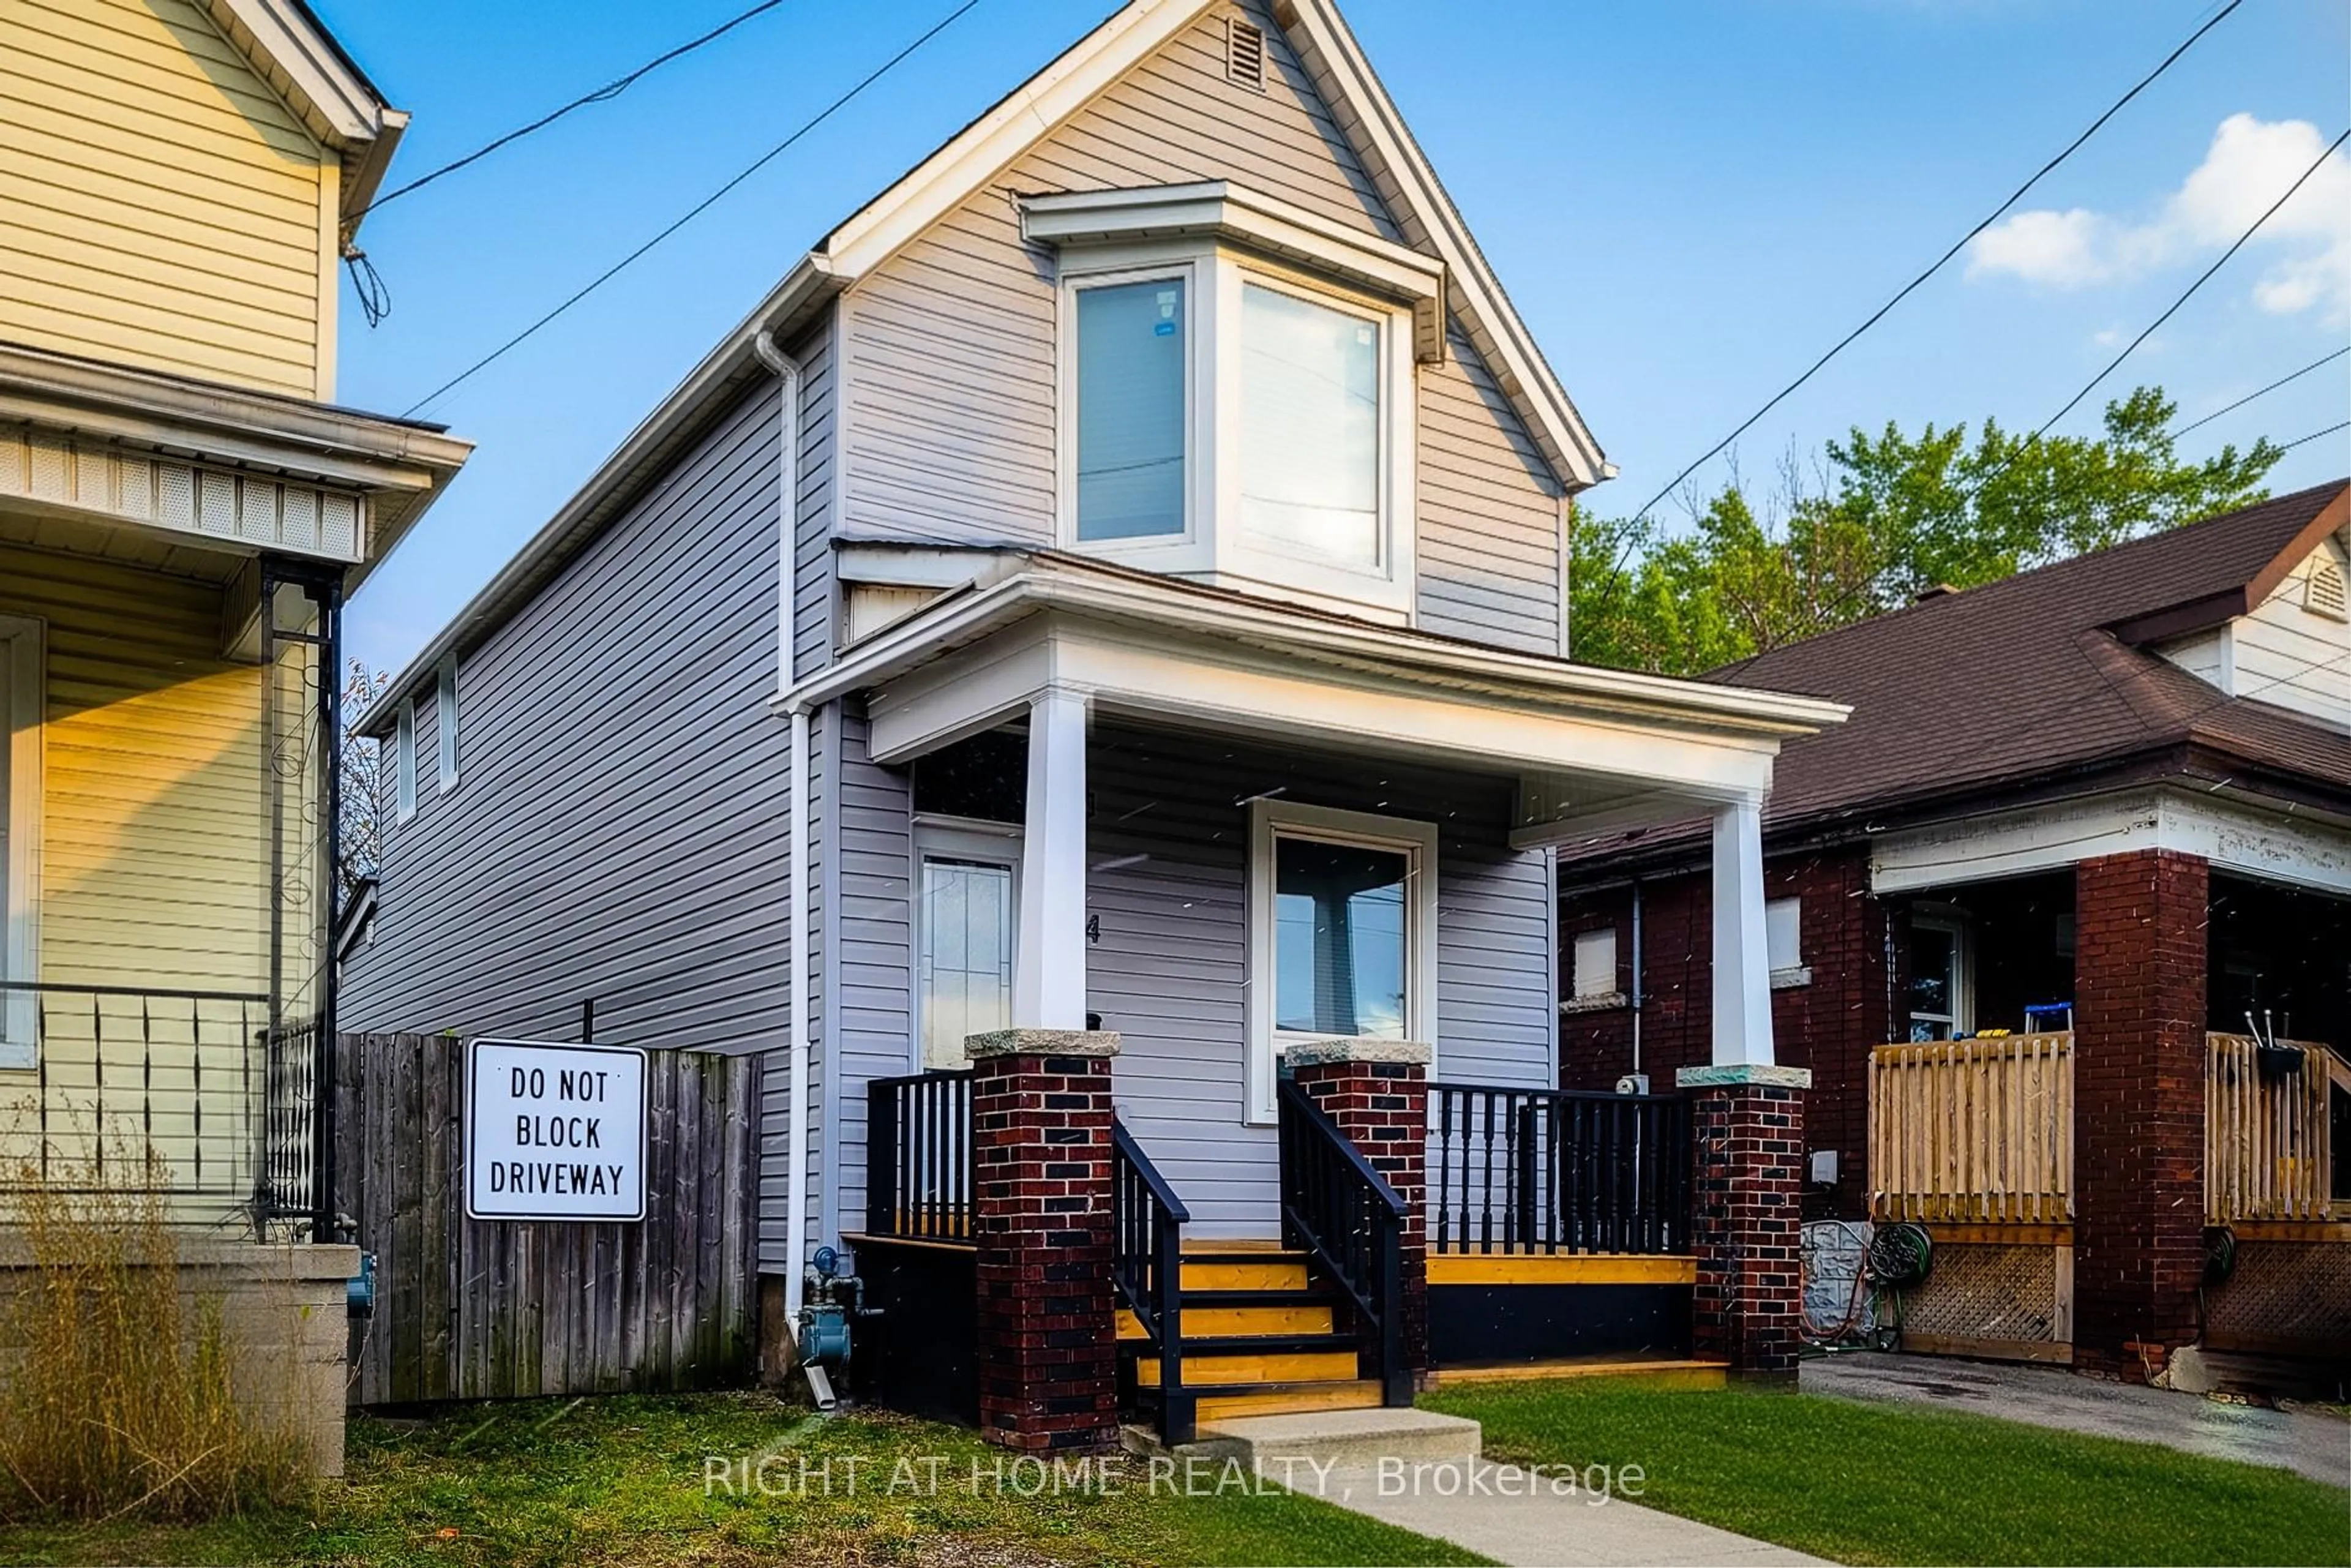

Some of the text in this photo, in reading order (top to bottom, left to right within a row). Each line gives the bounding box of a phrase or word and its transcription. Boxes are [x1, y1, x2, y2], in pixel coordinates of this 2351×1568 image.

[511, 1067, 607, 1102] DO NOT
[517, 1115, 601, 1149] BLOCK
[491, 1161, 623, 1195] DRIVEWAY
